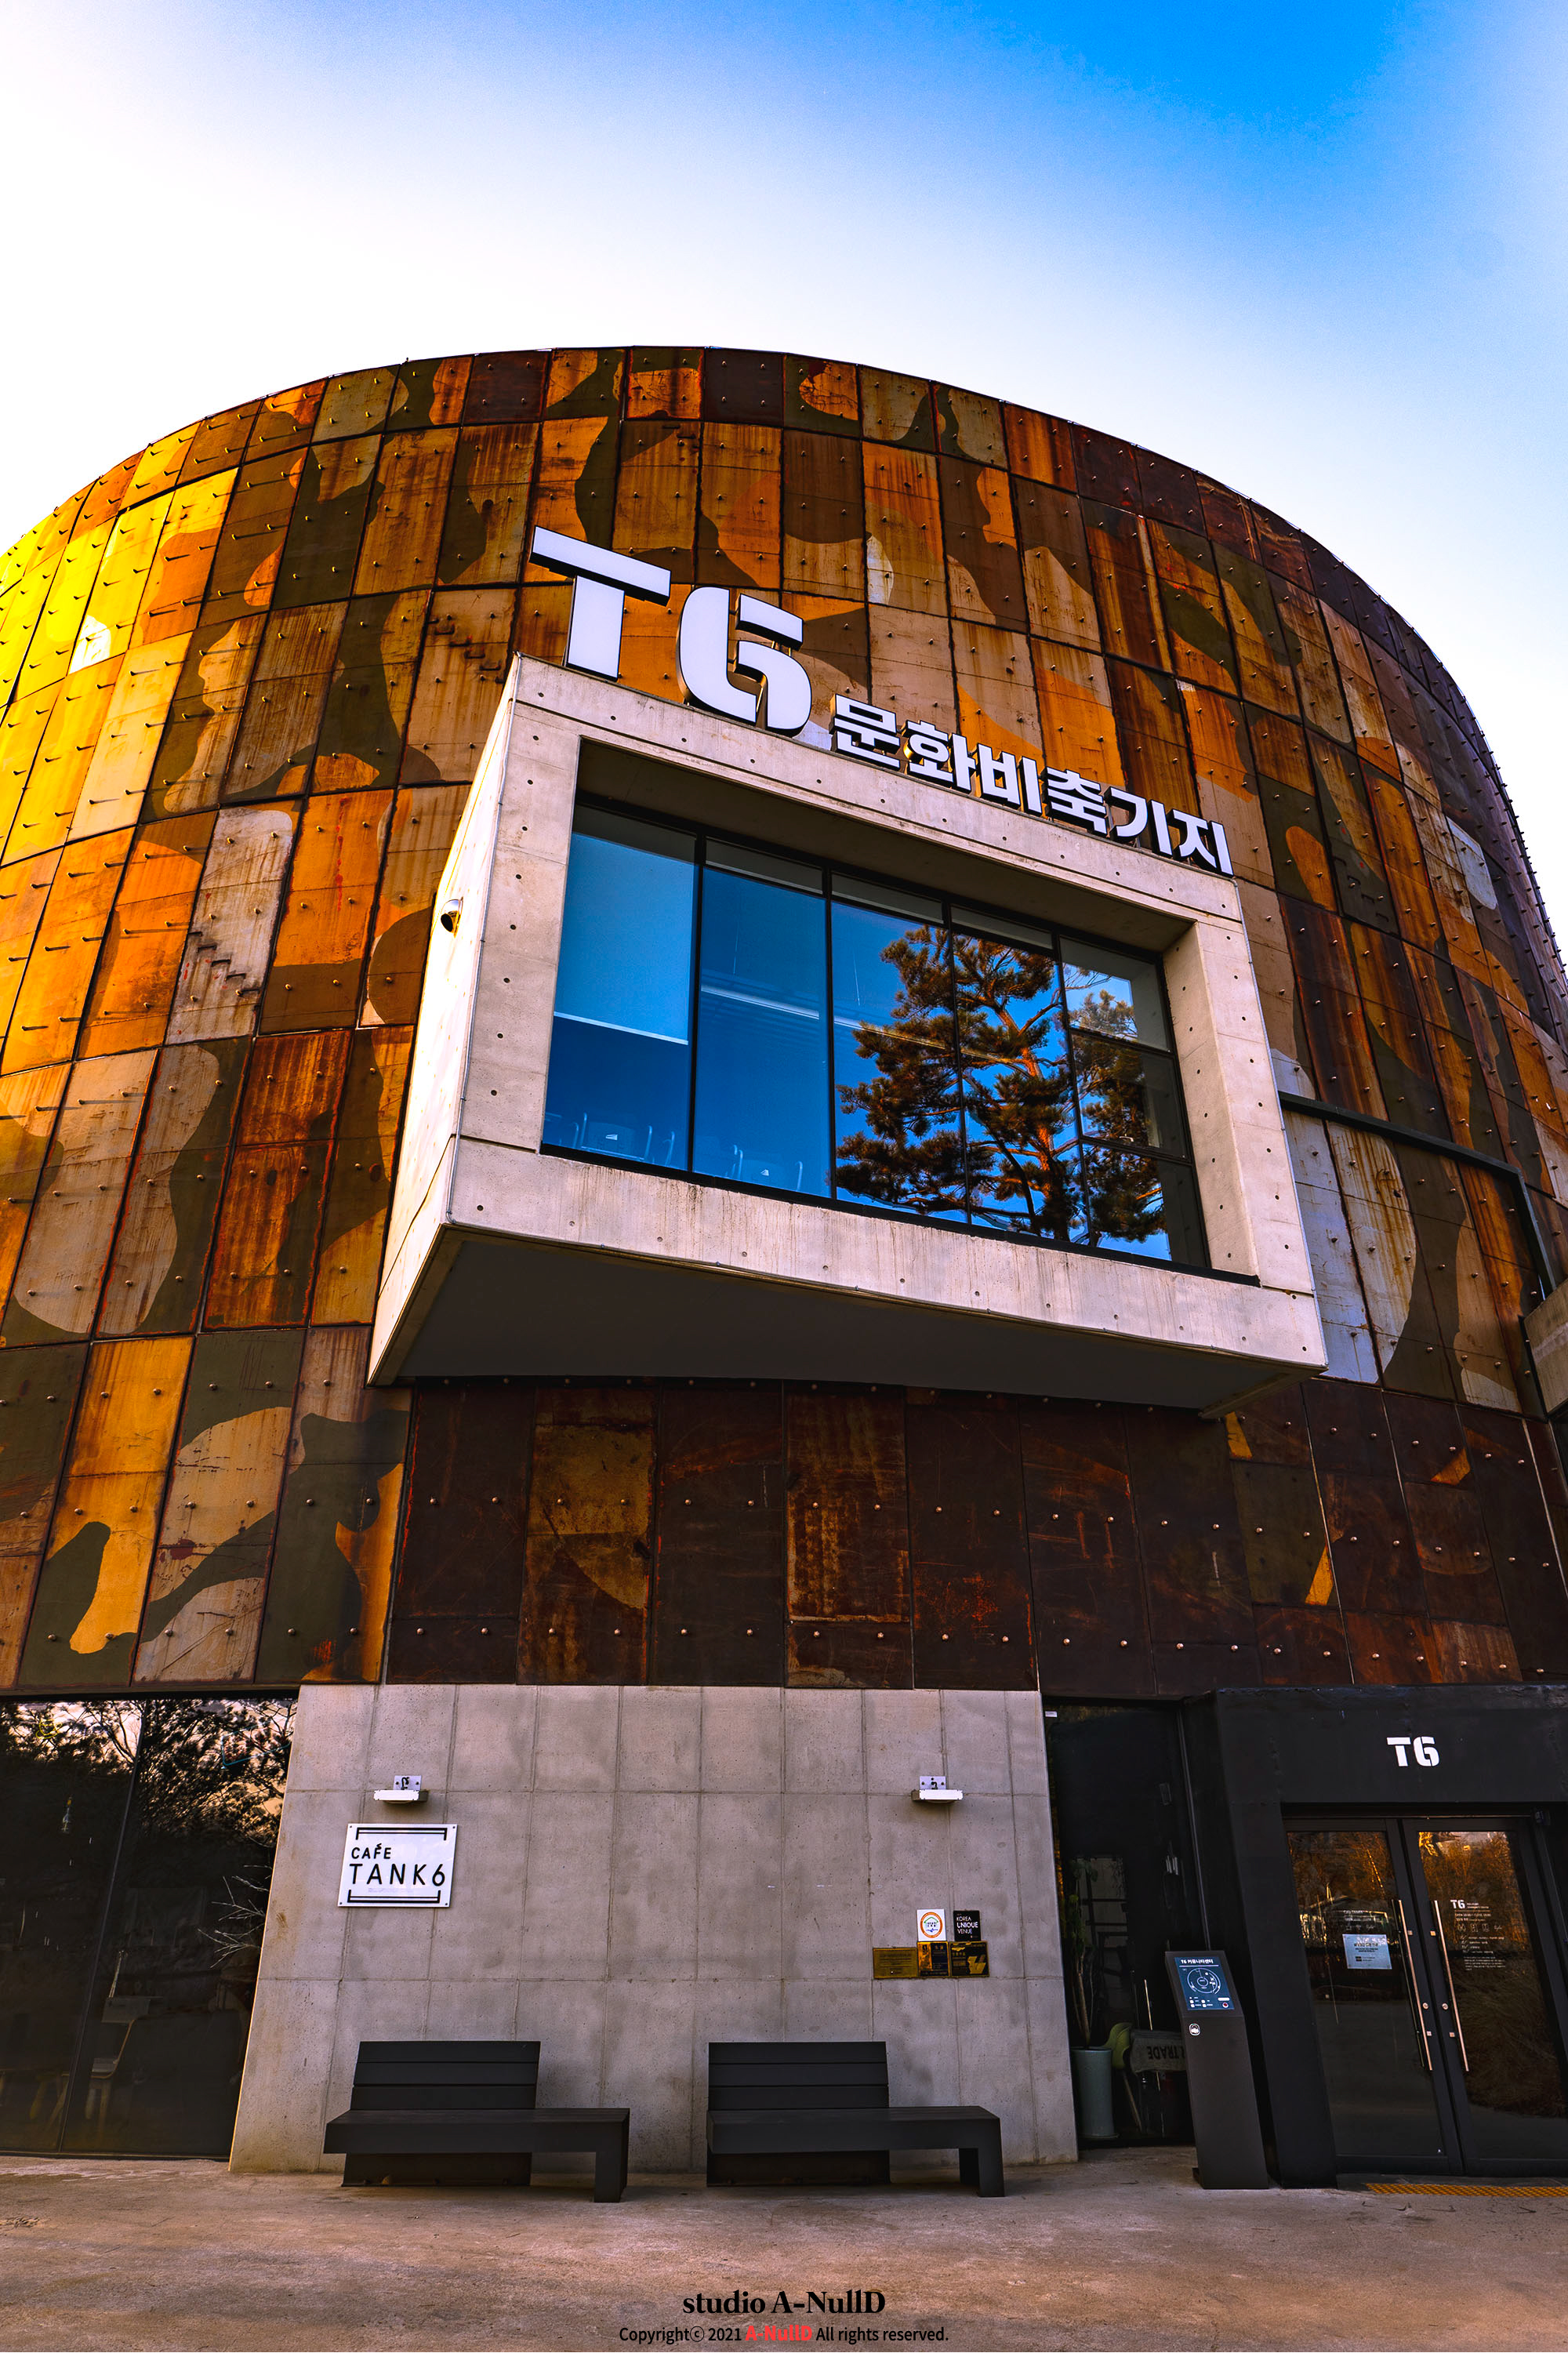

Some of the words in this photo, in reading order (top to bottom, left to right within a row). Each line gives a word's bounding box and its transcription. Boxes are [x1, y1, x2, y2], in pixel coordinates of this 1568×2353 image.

[530, 526, 813, 737] T6
[830, 694, 1234, 877] 문화비축기지
[1386, 1736, 1439, 1767] T6
[350, 1863, 445, 1886] TANK6
[1450, 1899, 1466, 1909] T6
[1147, 2045, 1179, 2061] TRADE
